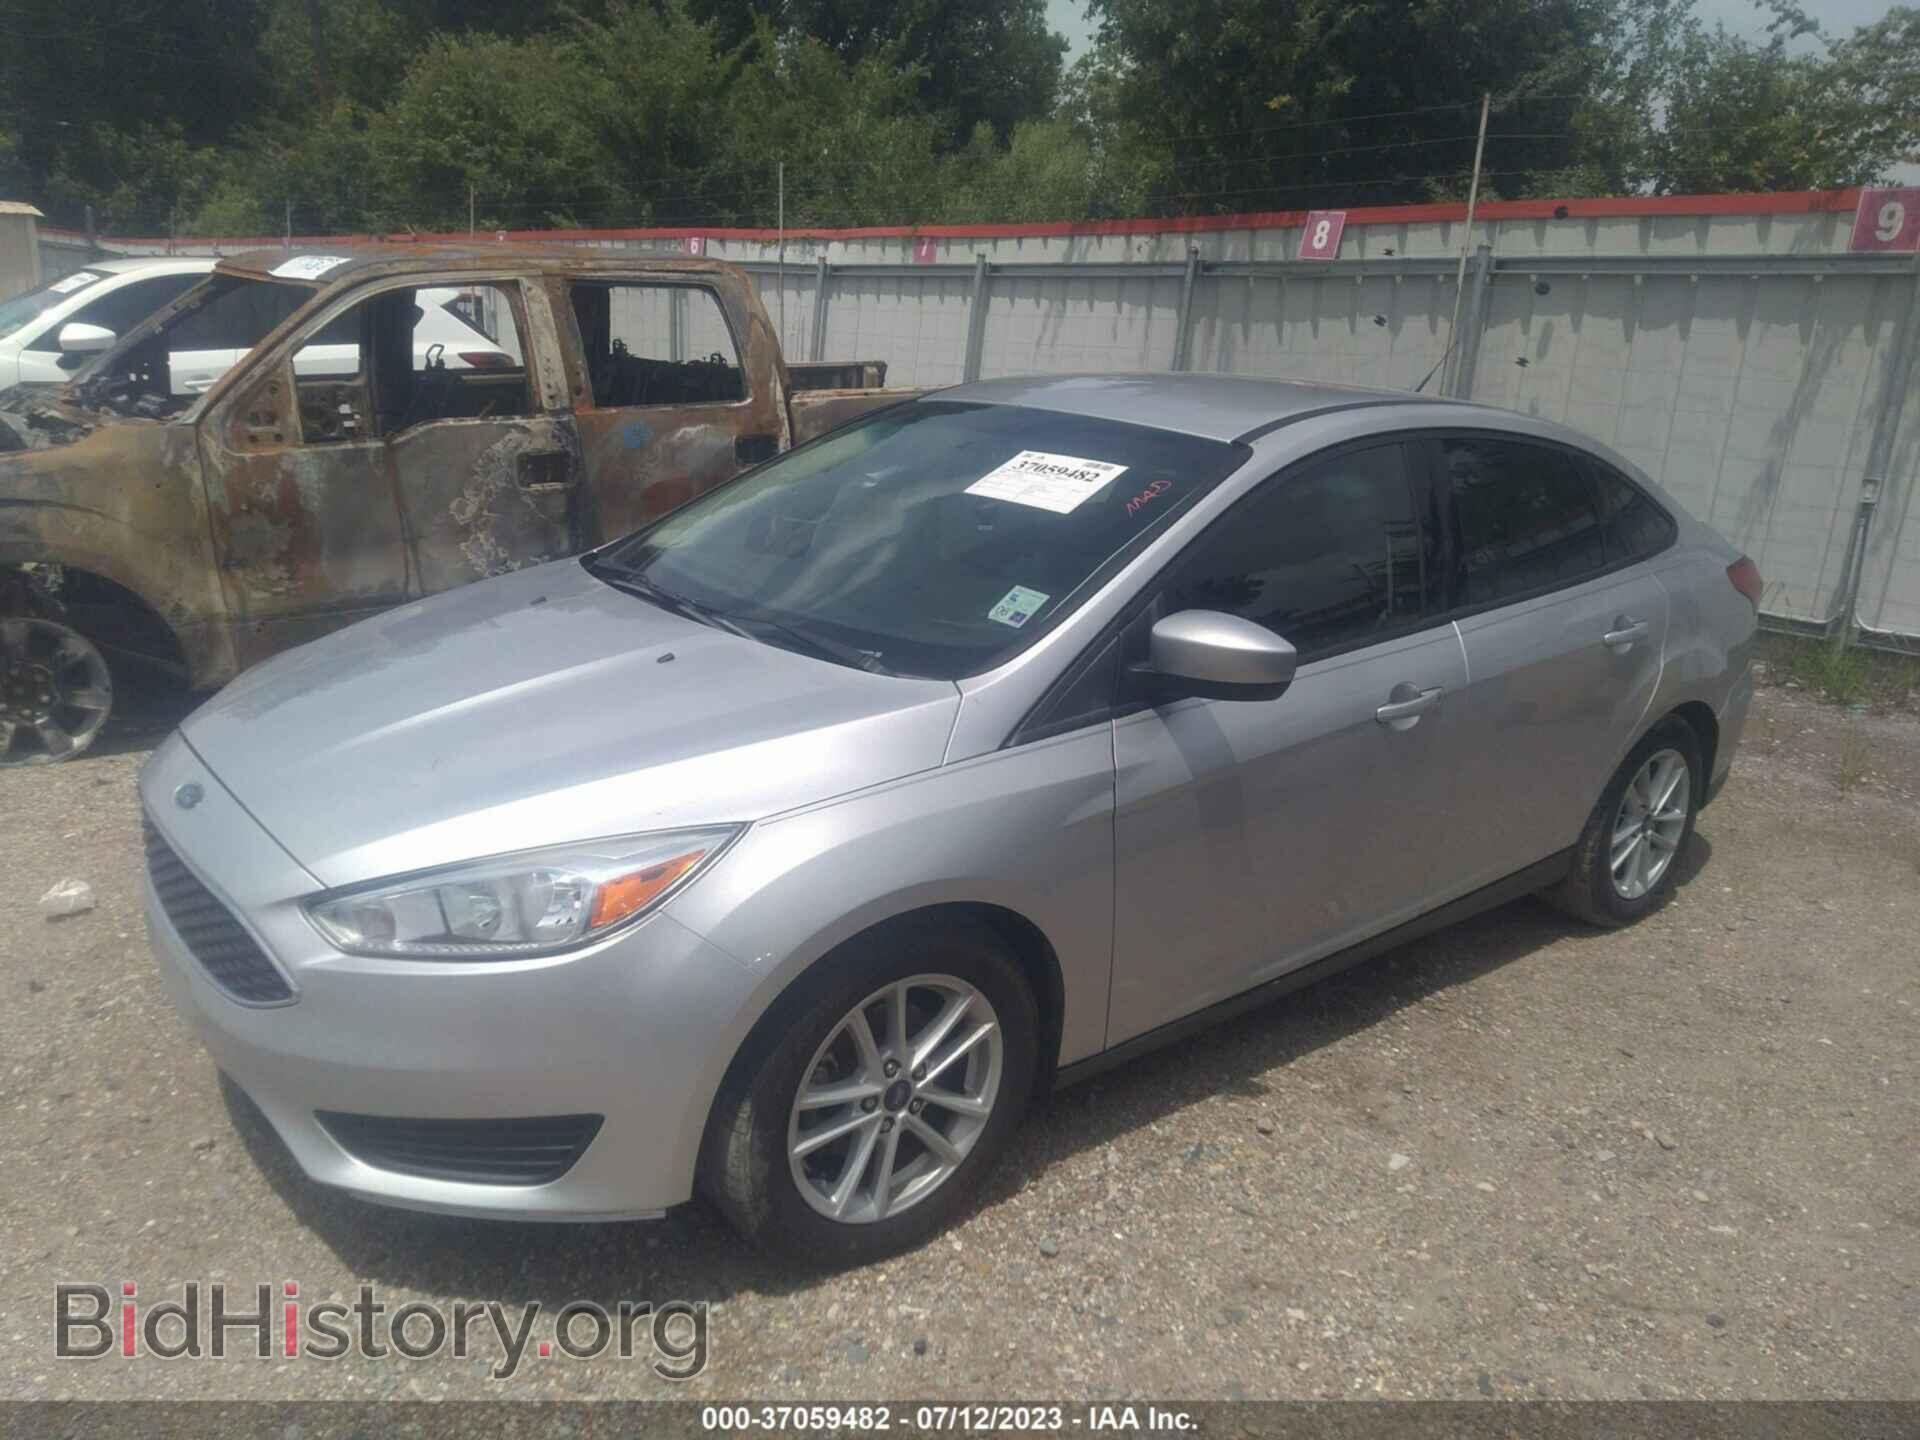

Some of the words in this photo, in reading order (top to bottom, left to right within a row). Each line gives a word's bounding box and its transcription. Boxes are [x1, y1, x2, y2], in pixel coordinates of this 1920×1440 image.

[1874, 201, 1905, 242] 9
[690, 237, 699, 255] 6
[1312, 220, 1330, 250] 8
[1012, 460, 1100, 482] 37059482
